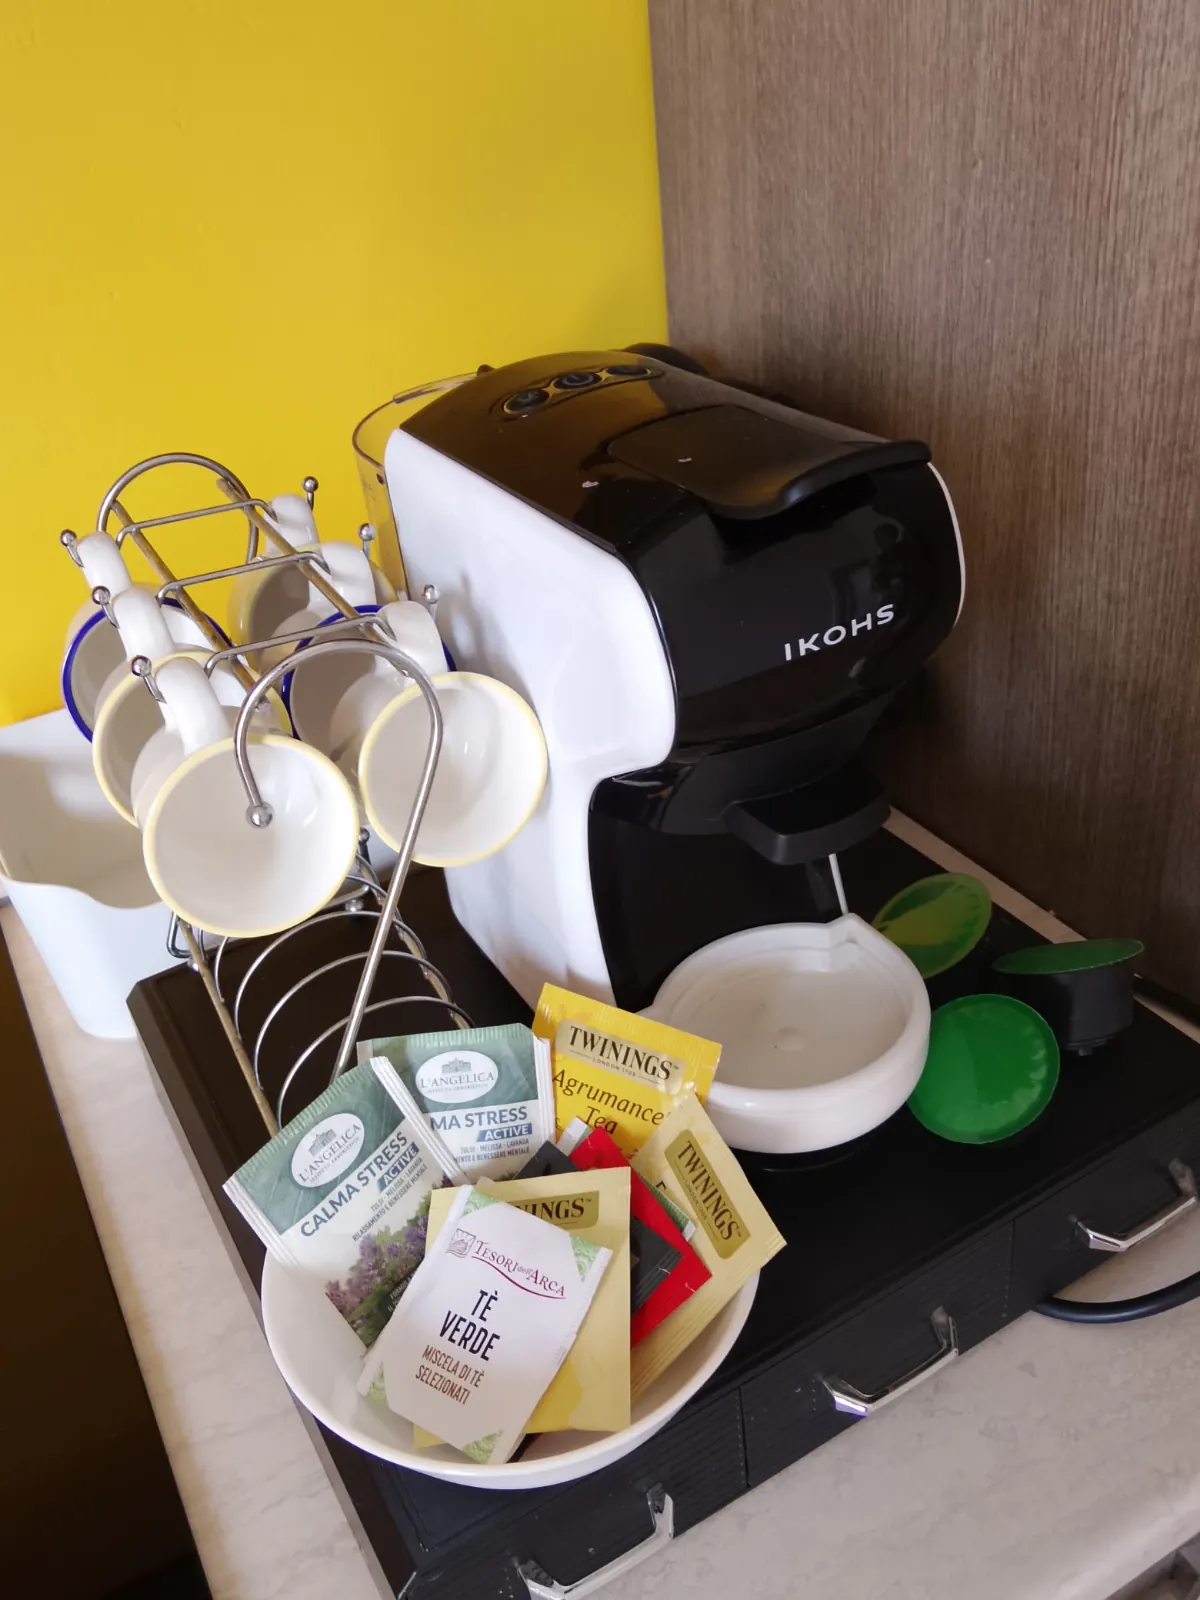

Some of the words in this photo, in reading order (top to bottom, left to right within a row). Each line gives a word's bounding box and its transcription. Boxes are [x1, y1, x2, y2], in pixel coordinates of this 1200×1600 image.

[784, 604, 894, 661] IKOHS
[569, 1025, 672, 1081] TWININGS
[420, 1072, 495, 1089] L'ANGELICA
[465, 1106, 528, 1128] STRESS
[485, 1125, 529, 1140] ACTIVE
[586, 1106, 618, 1135] Tea
[299, 1123, 361, 1182] L'ANGELICA
[383, 1146, 417, 1186] ACTIVE
[300, 1183, 360, 1237] CALMA
[356, 1131, 408, 1187] STRESS
[677, 1140, 739, 1241] TWININGS
[513, 1197, 585, 1220] INGS
[474, 1240, 518, 1273] TESORI
[471, 1289, 498, 1322] TÈ
[439, 1310, 500, 1362] VERDE
[415, 1365, 471, 1405] SELEZIONATI
[422, 1345, 458, 1375] MISCELA
[459, 1361, 471, 1380] DI
[470, 1369, 485, 1388] TÈ
